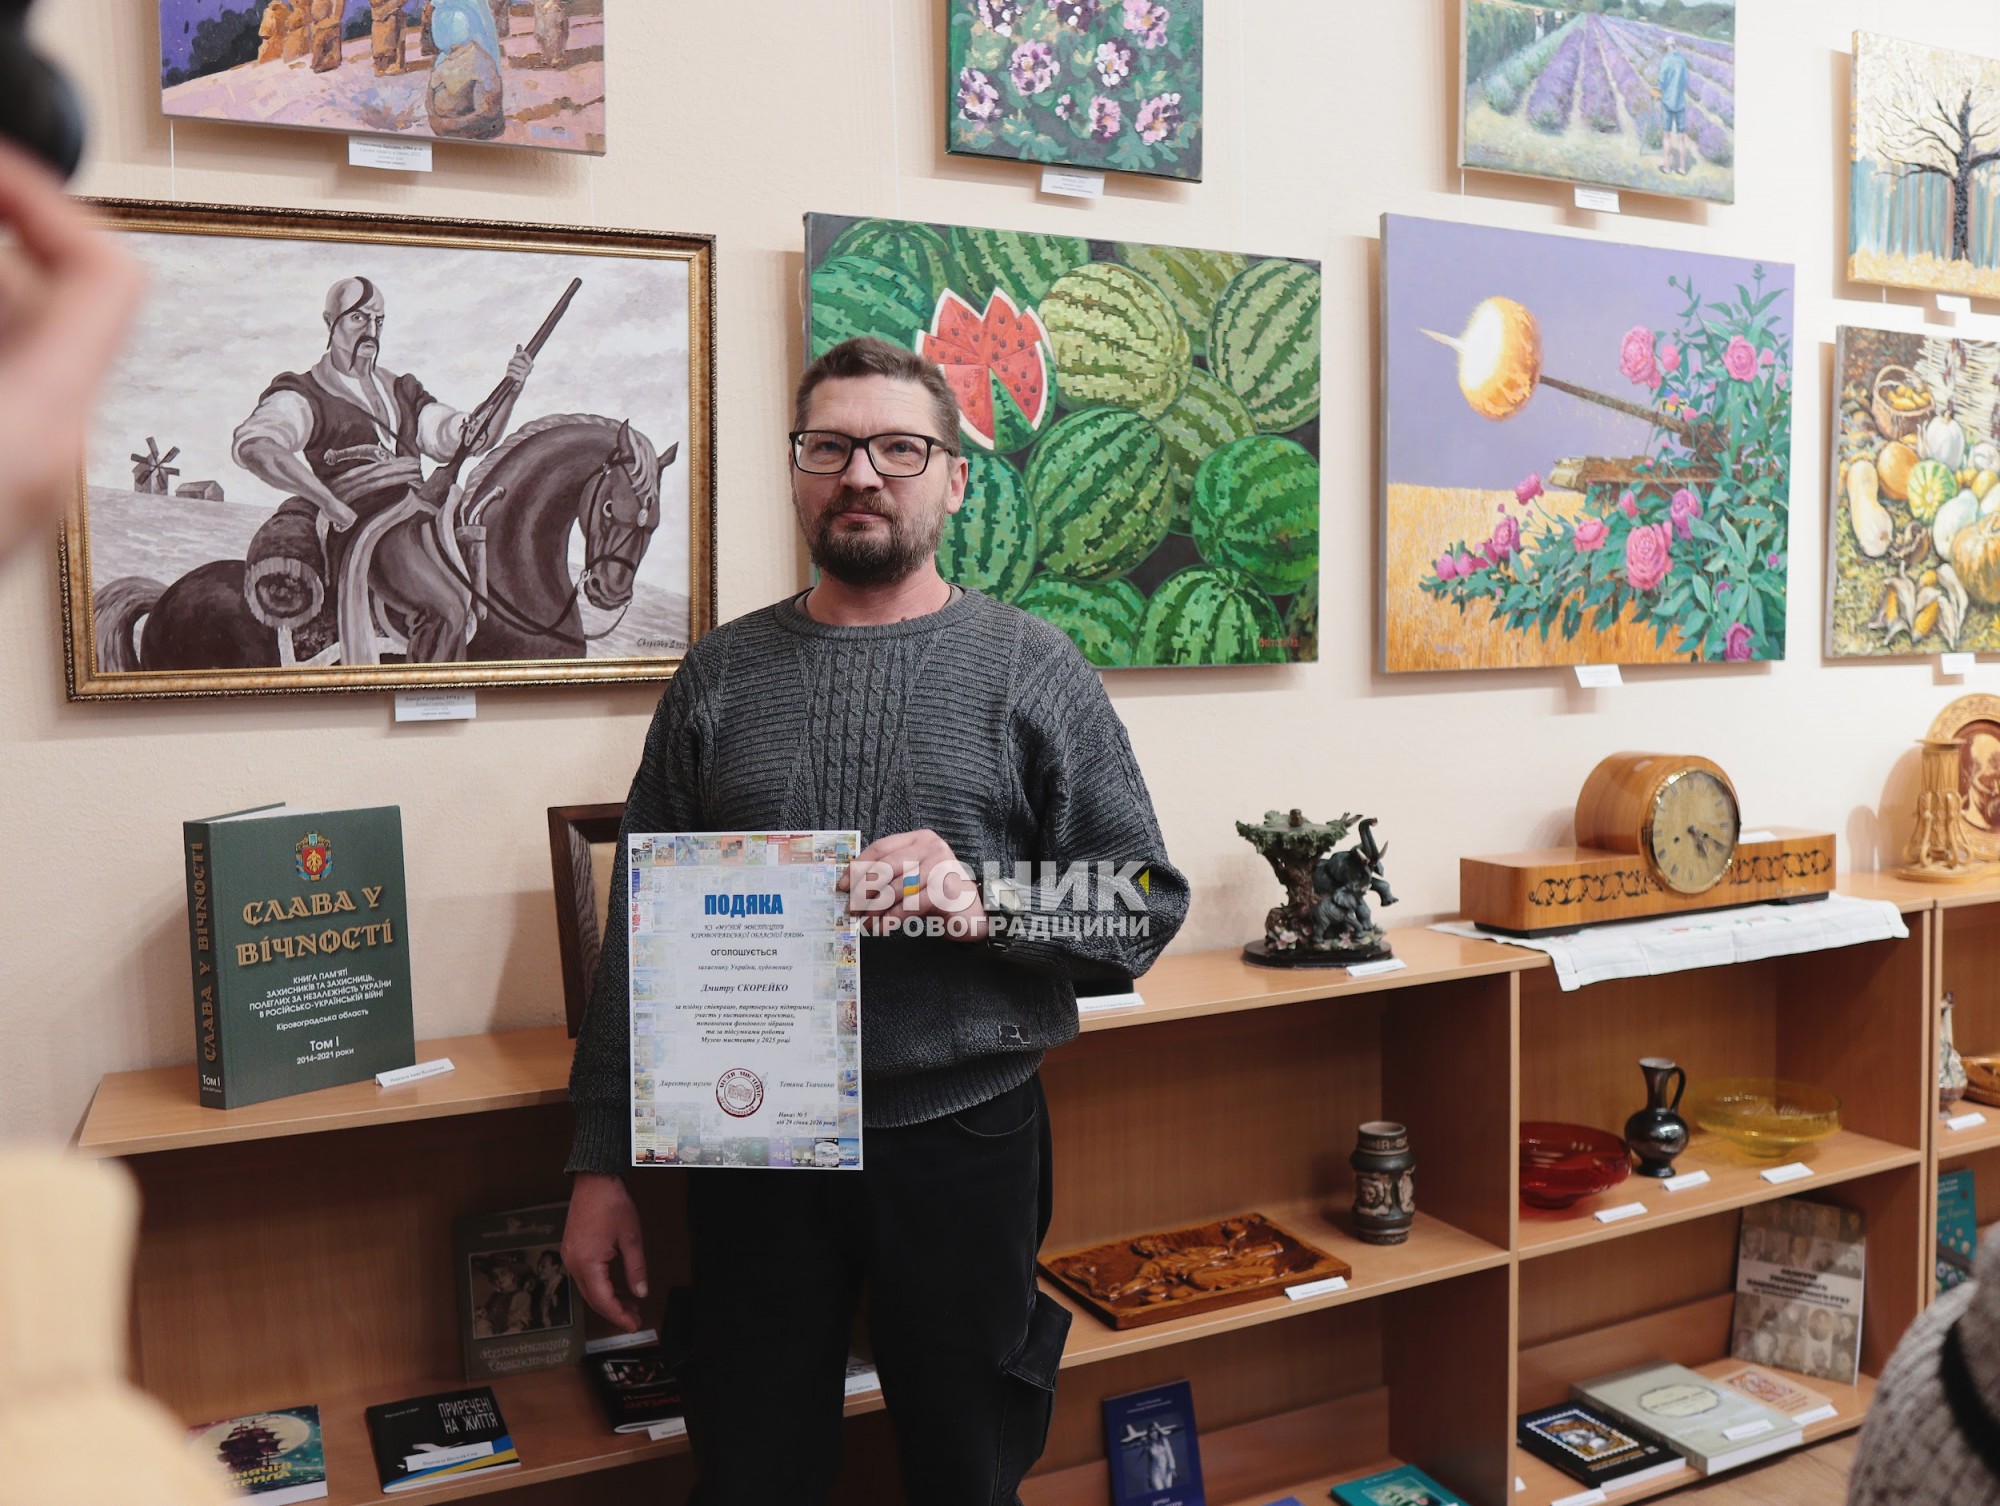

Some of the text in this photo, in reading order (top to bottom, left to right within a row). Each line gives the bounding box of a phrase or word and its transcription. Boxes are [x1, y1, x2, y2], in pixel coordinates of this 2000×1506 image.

[243, 885, 382, 926] СЛАВА У
[704, 894, 784, 918] ПОДЯКА
[235, 918, 393, 966] ВІЧНОСТІ
[266, 974, 375, 998] ЗАХИСНИКІВ ТА ЗАХИСНИЦЬ,
[293, 974, 318, 984] КНИГА
[700, 982, 789, 994] Дмитру СКОРЕЙКО
[249, 979, 392, 1011] ПОЛЕГЛИХ ЗА НЕЗАЛЕЖНІСТЬ УКРАЇНИ
[259, 988, 384, 1019] В РОСІЙСЬКО-УКРАЇНСЬКІЙ ВІЙНІ
[276, 1008, 369, 1032] Кіровоградська область
[309, 1039, 333, 1052] Том
[335, 1048, 355, 1059] роки
[202, 1074, 217, 1086] Том
[658, 1080, 691, 1088] Директор
[779, 1080, 803, 1088] Тетяна
[438, 1397, 493, 1418] ПРИРЕЧЕНІ
[443, 1412, 499, 1434] НА ЖИТТЯ
